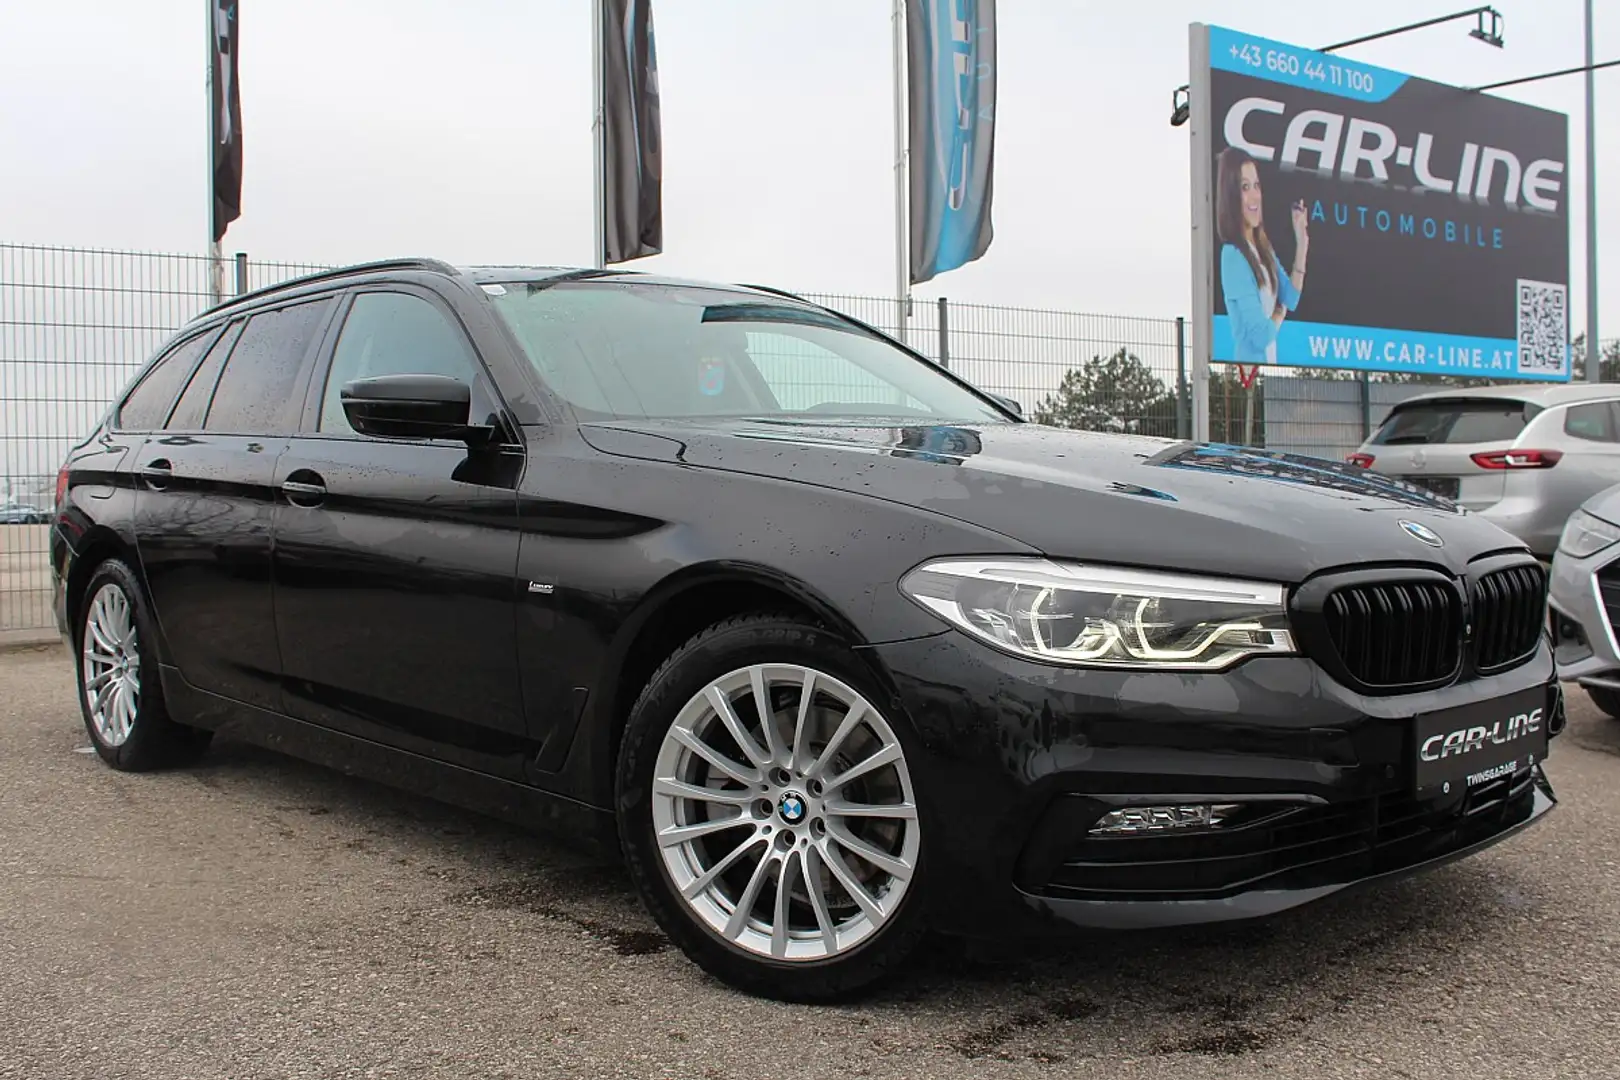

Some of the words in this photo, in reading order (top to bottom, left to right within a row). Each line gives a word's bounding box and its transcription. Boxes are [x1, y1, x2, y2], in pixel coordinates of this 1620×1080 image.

[1229, 43, 1262, 68] +43
[1266, 50, 1299, 76] 660
[1303, 59, 1326, 82] 44
[1329, 65, 1342, 87] 11
[1345, 69, 1374, 93] 100
[1224, 97, 1565, 212] CAR-LINE
[1311, 200, 1503, 249] AUTOMOBILE
[1308, 335, 1513, 370] WWW.CAR-LINE.AT
[1420, 707, 1543, 762] CAR-LINE
